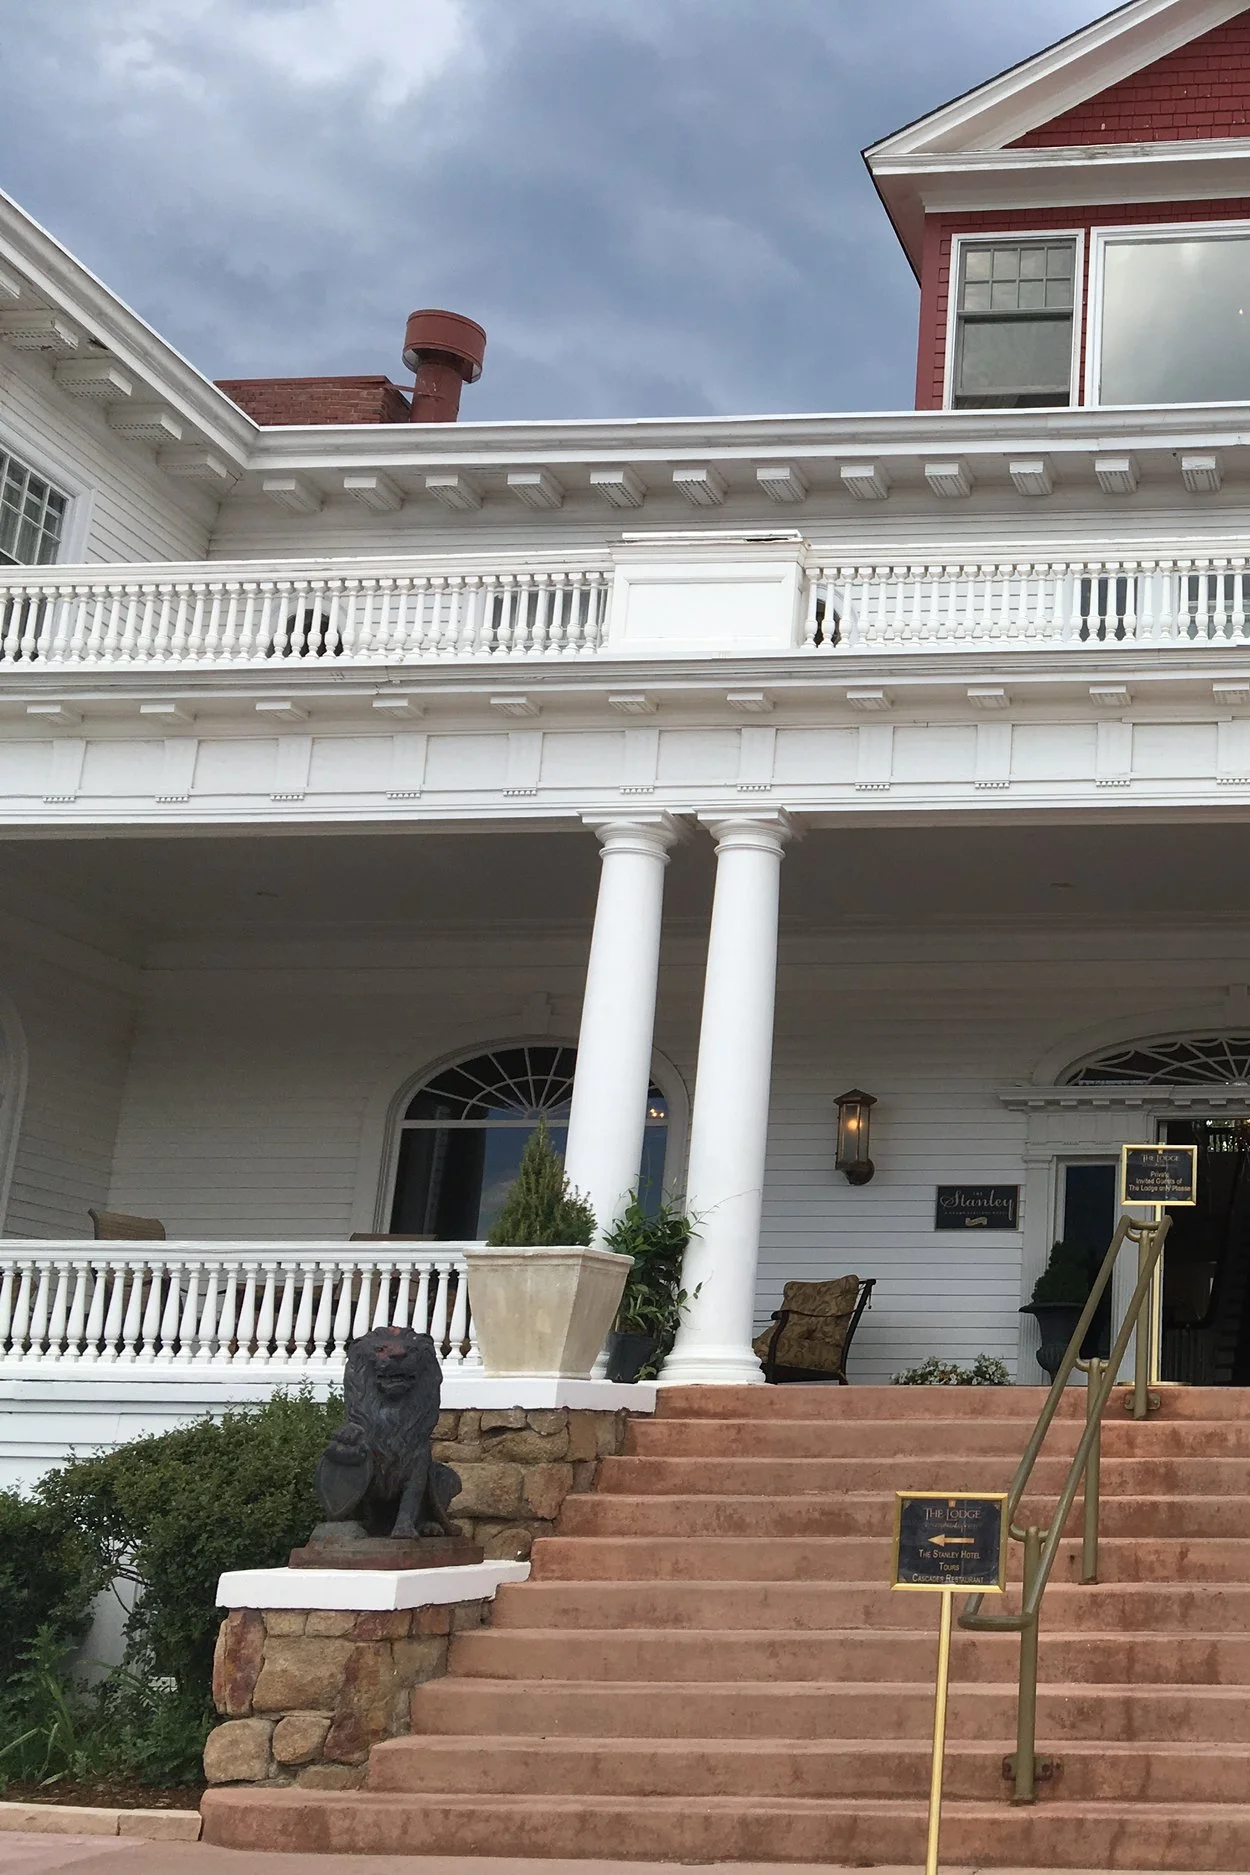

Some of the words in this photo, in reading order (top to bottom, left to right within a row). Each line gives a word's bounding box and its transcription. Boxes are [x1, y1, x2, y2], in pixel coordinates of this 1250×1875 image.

[939, 1189, 1014, 1221] Stanley
[923, 1507, 944, 1520] THE
[946, 1508, 981, 1521] LODGE
[919, 1549, 932, 1558] THE
[932, 1550, 959, 1559] STANLEY
[960, 1550, 981, 1559] HOTEL
[939, 1562, 960, 1571] TOURS
[912, 1573, 944, 1582] CASCADES
[945, 1574, 984, 1583] RESTAURANT
